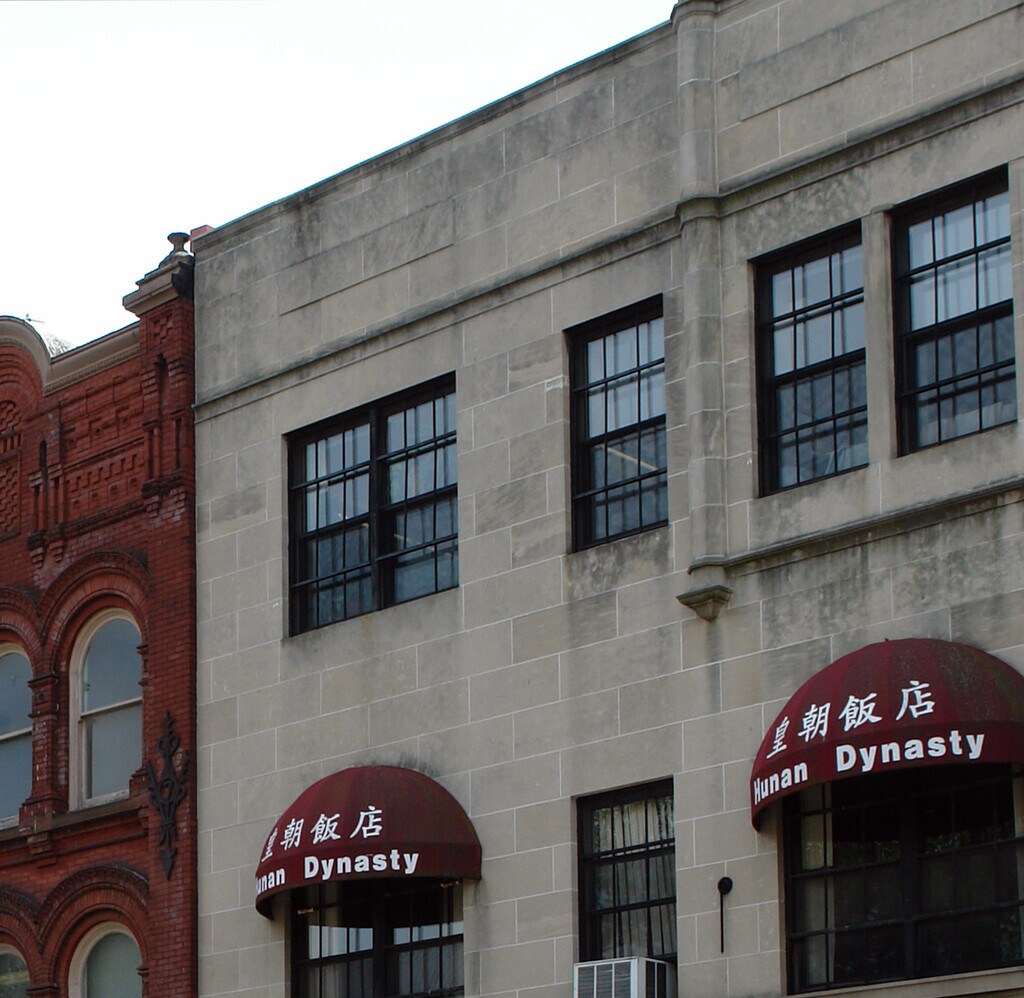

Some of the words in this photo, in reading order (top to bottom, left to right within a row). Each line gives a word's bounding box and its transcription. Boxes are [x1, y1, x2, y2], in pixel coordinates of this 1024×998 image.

[766, 680, 935, 760] 皇朝飯店
[753, 761, 808, 805] Hunan
[836, 730, 985, 772] Dynasty
[304, 849, 419, 880] Dynasty
